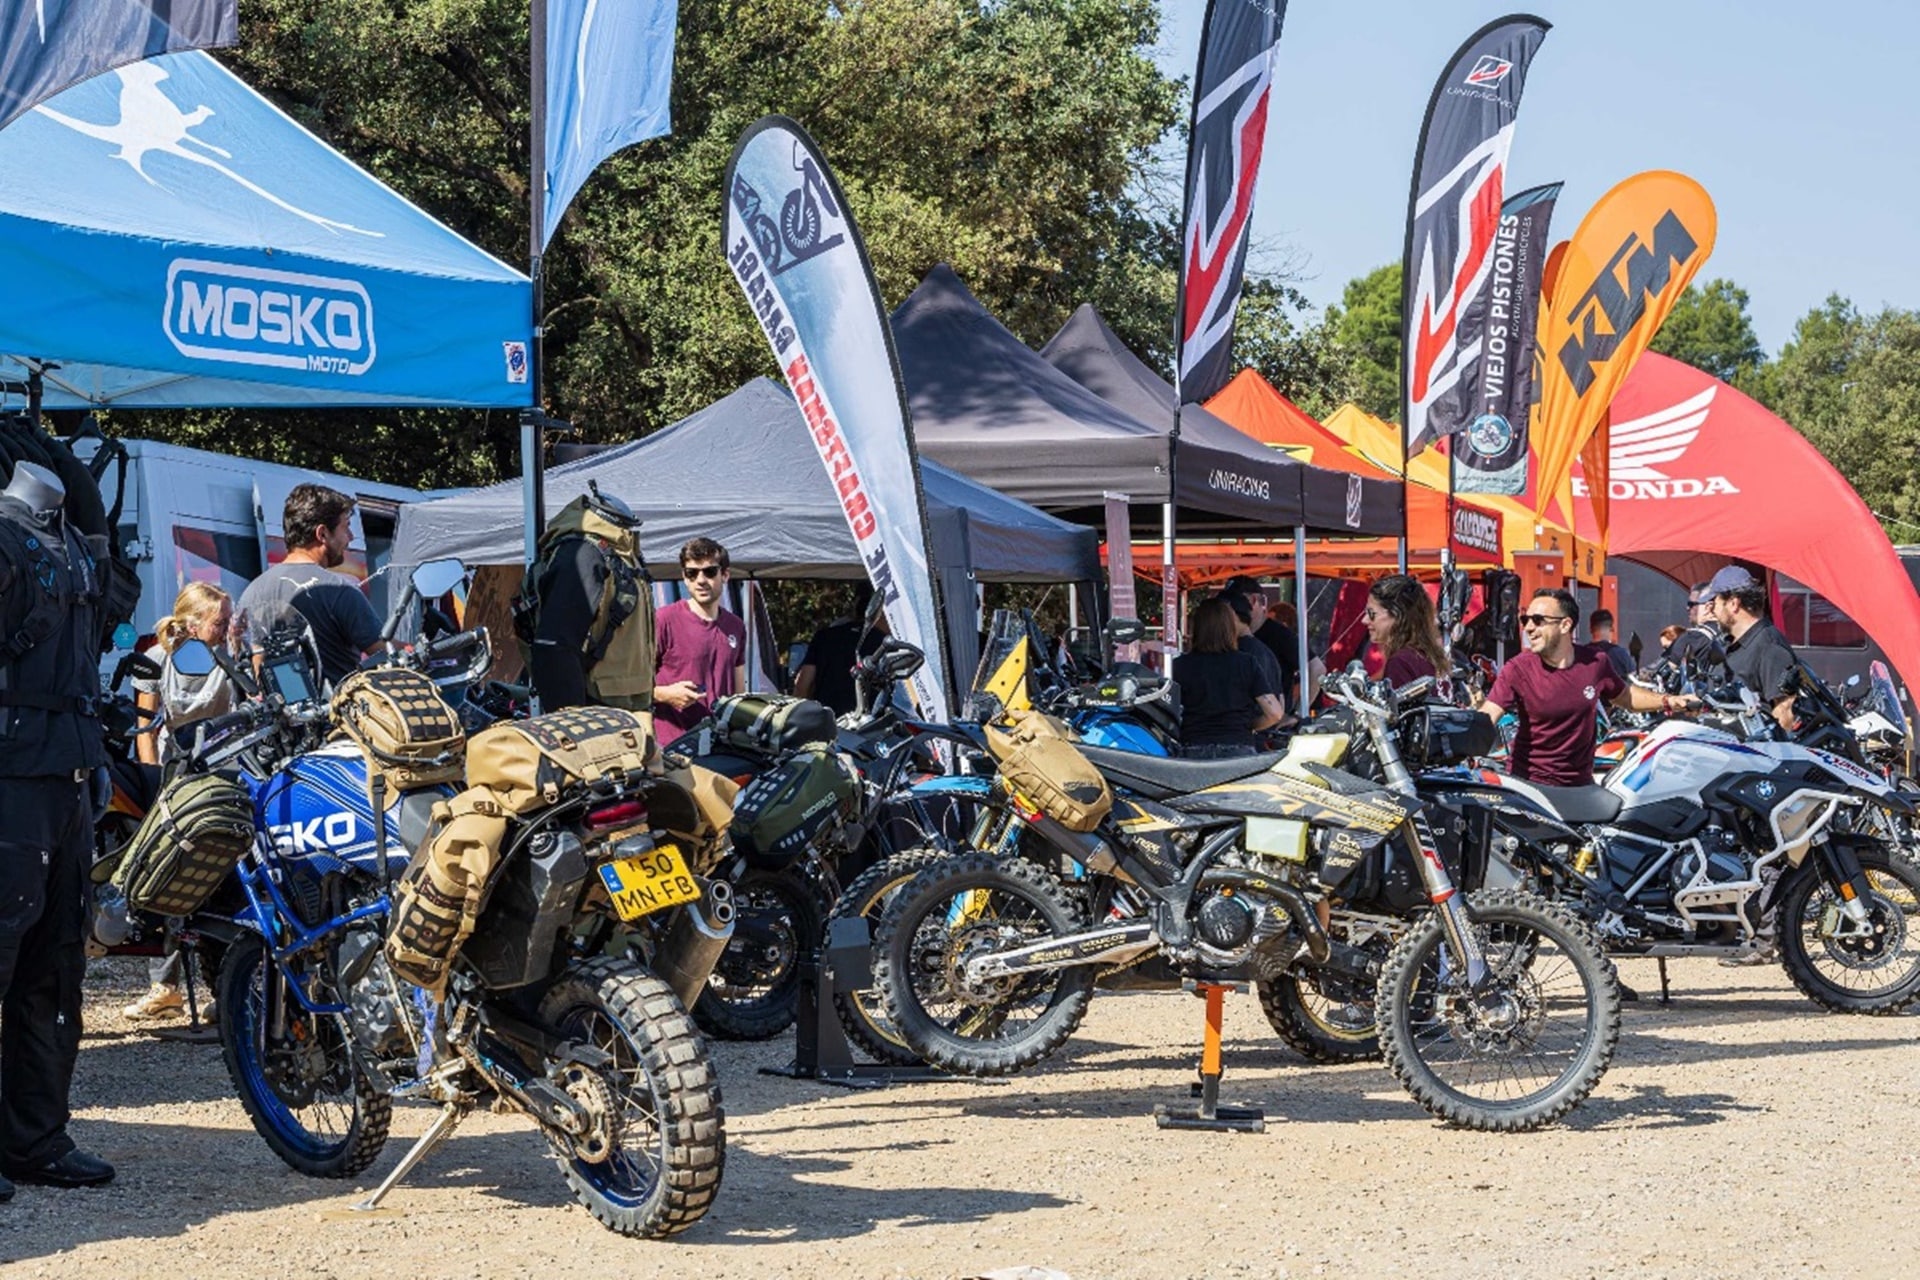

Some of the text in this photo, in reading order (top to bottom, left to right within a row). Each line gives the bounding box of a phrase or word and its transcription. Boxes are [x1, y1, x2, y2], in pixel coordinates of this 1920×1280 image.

[179, 280, 362, 351] MOSKO
[1484, 213, 1519, 399] VIEJOS PISTONES
[1558, 208, 1698, 399] KTM
[307, 354, 349, 374] MOTO
[1571, 476, 1741, 500] HONDA
[252, 811, 356, 864] SKO
[617, 875, 694, 914] MN-FB
